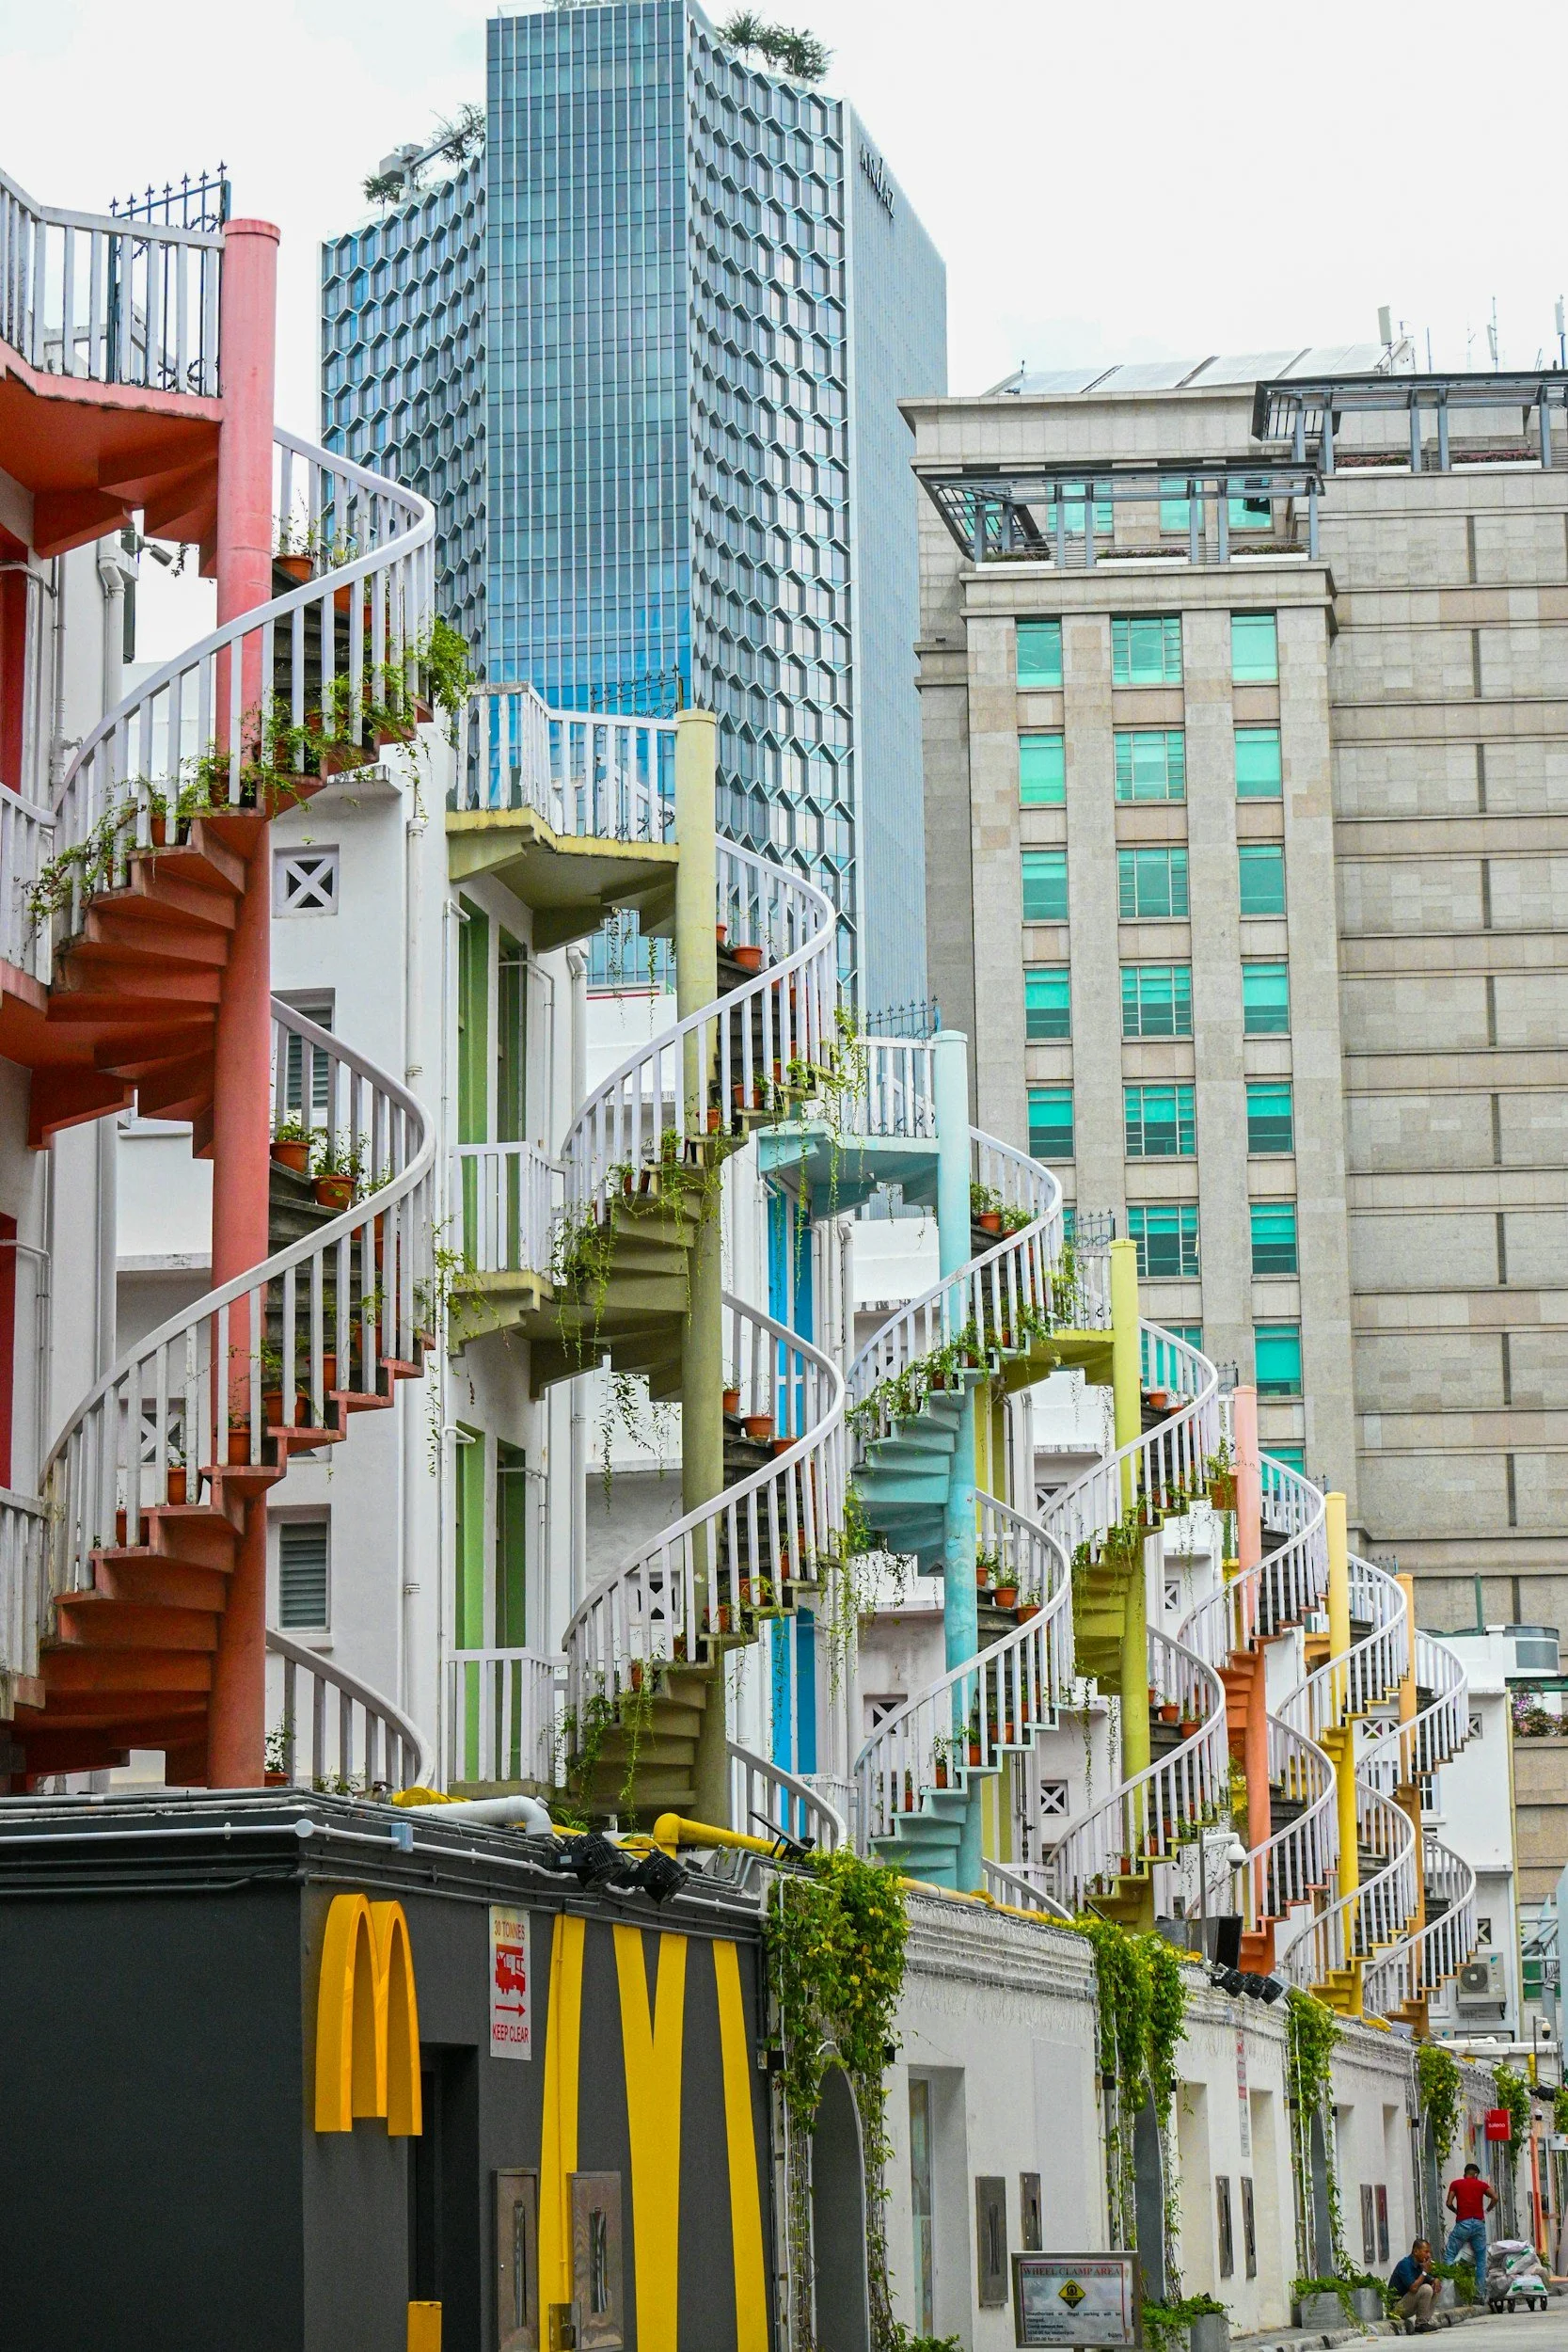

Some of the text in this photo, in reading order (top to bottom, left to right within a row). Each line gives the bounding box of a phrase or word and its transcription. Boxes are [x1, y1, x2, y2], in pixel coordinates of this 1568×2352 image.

[494, 1919, 525, 1940] 30 TONNES
[492, 2023, 530, 2043] KEEP CLEAR
[1023, 2267, 1056, 2276] WHEEL
